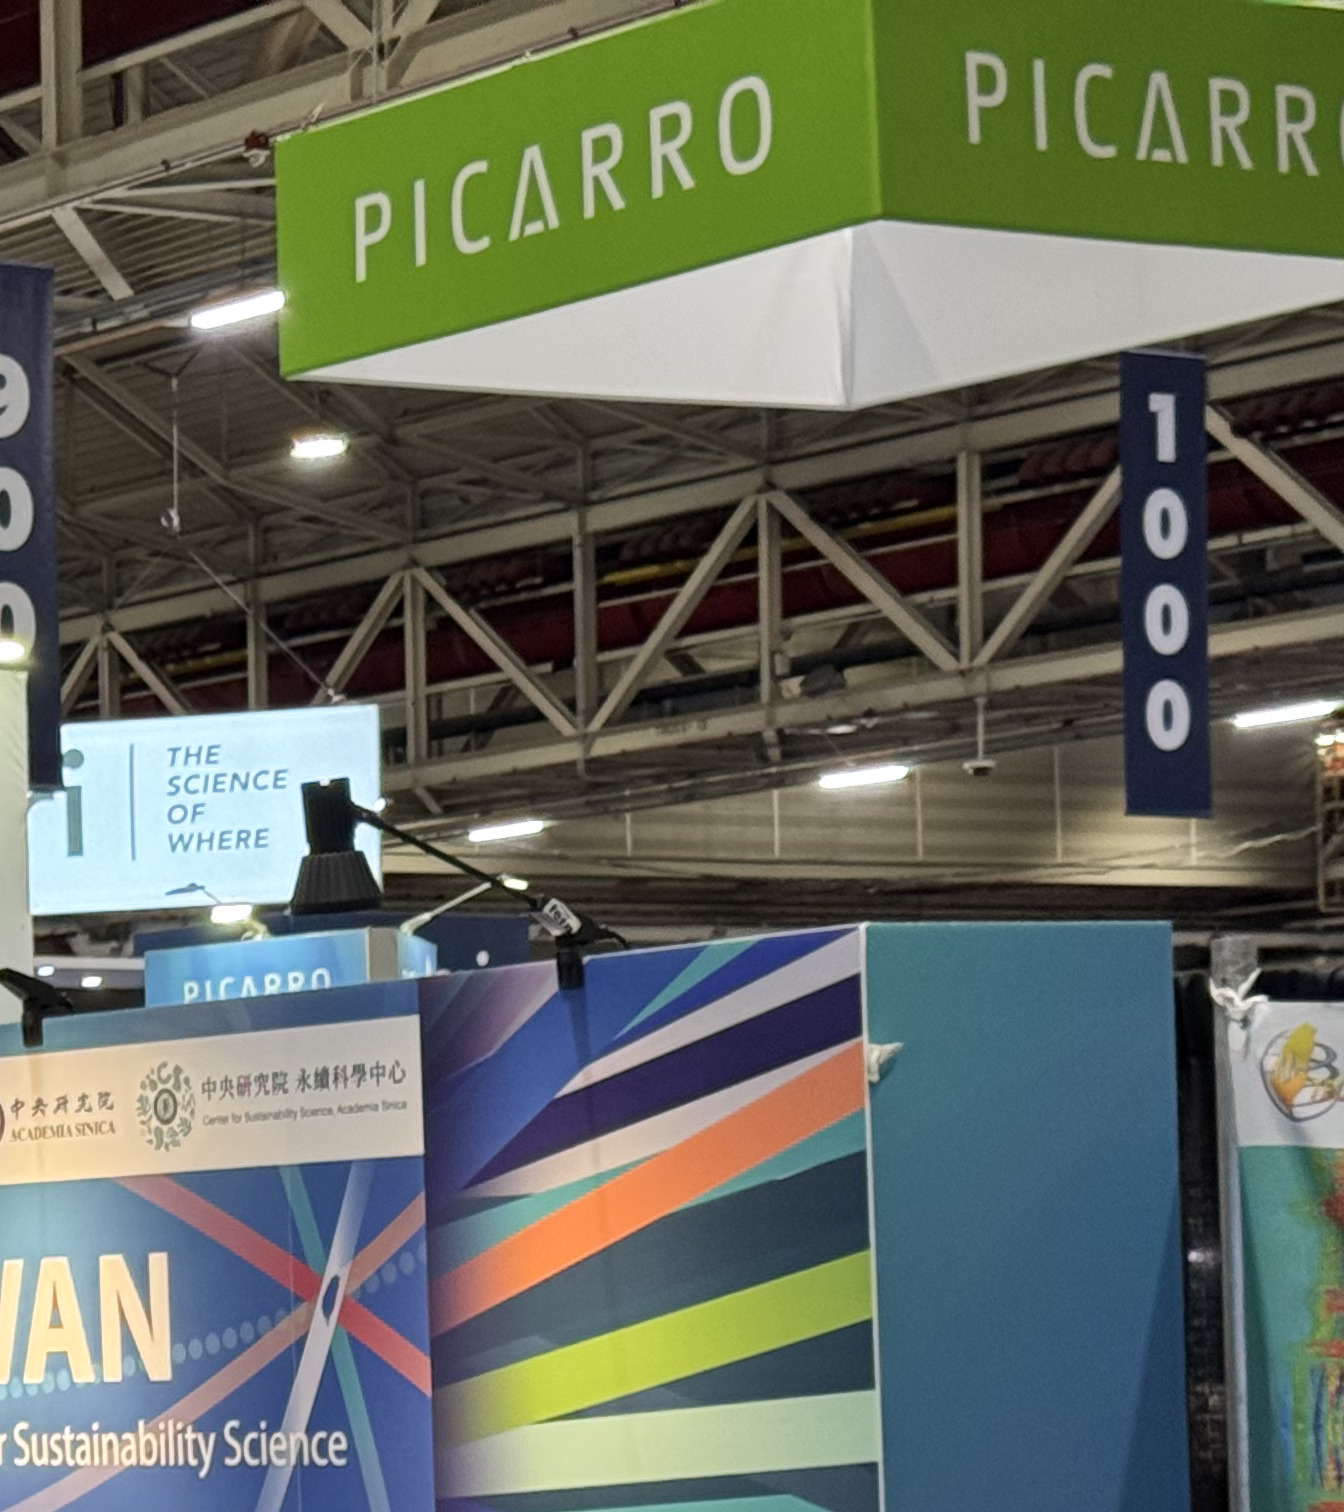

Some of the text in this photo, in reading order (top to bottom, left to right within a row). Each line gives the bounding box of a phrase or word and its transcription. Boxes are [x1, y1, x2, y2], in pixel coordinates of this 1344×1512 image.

[963, 50, 1344, 177] PICARR
[354, 75, 774, 284] PICARRO
[1143, 392, 1191, 752] 1000
[166, 744, 222, 768] THE
[165, 768, 289, 797] SCIENCE
[167, 803, 206, 825] OF
[166, 828, 271, 853] WHERE
[183, 967, 332, 1005] PICARRO
[9, 1121, 116, 1143] ACADEMIA SINICA
[13, 1418, 217, 1478] Sustainability
[223, 1418, 349, 1468] Science
